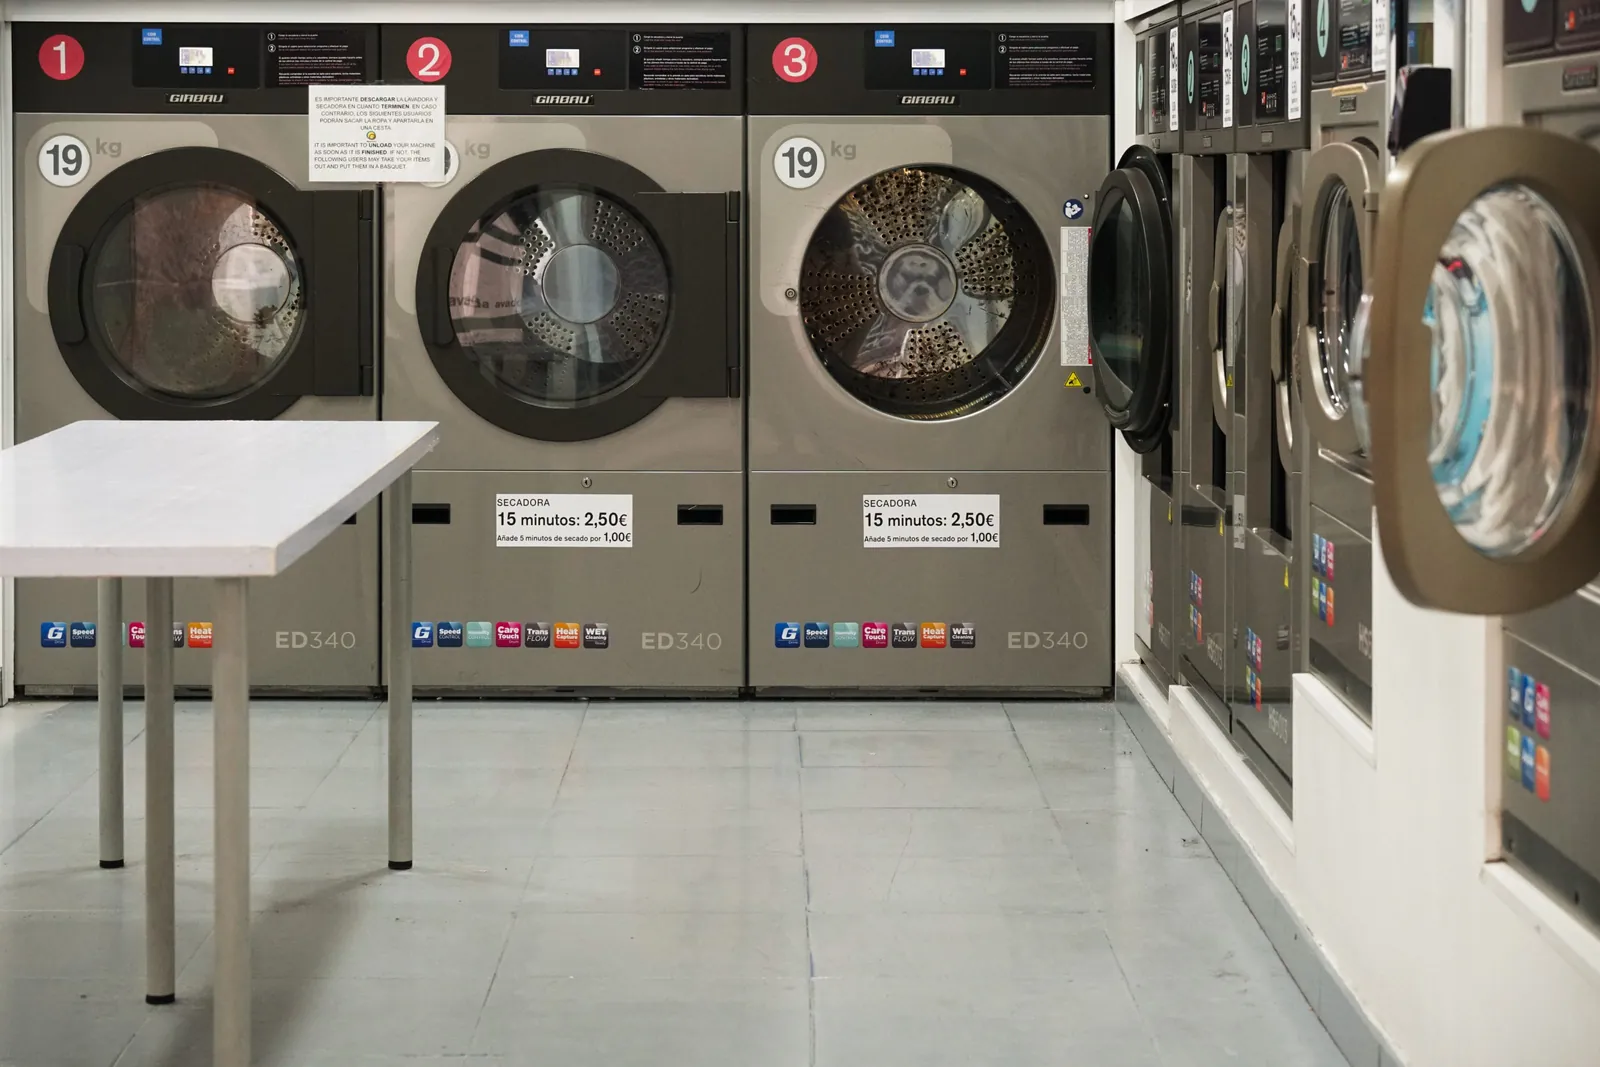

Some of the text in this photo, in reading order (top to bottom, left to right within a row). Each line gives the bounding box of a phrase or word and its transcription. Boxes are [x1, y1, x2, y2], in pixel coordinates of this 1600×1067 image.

[1319, 0, 1326, 48] 4
[53, 41, 67, 74] 1
[418, 44, 440, 76] 2
[783, 44, 807, 77] 3
[1243, 44, 1248, 87] 3
[170, 94, 224, 103] GIRBAU
[536, 95, 590, 104] GIRBAU
[901, 96, 955, 104] GIRBAU
[46, 138, 122, 175] 19 kg
[465, 140, 490, 158] kg
[782, 141, 857, 178] 19 kg
[497, 498, 550, 507] SECADORA
[863, 499, 917, 507] SECADORA
[498, 512, 628, 528] 15 minutos: 2,50€
[865, 513, 994, 529] 15 minutos: 2,50€
[497, 534, 518, 542] Añade
[603, 532, 631, 543] 1,00€
[864, 535, 886, 543] Añade
[970, 533, 998, 544] 1,00€
[48, 627, 64, 639] G
[415, 626, 431, 639] G
[497, 626, 519, 634] Care
[781, 628, 798, 640] G
[276, 631, 356, 649] ED340
[642, 632, 722, 650] ED340
[1008, 632, 1088, 649] ED340
